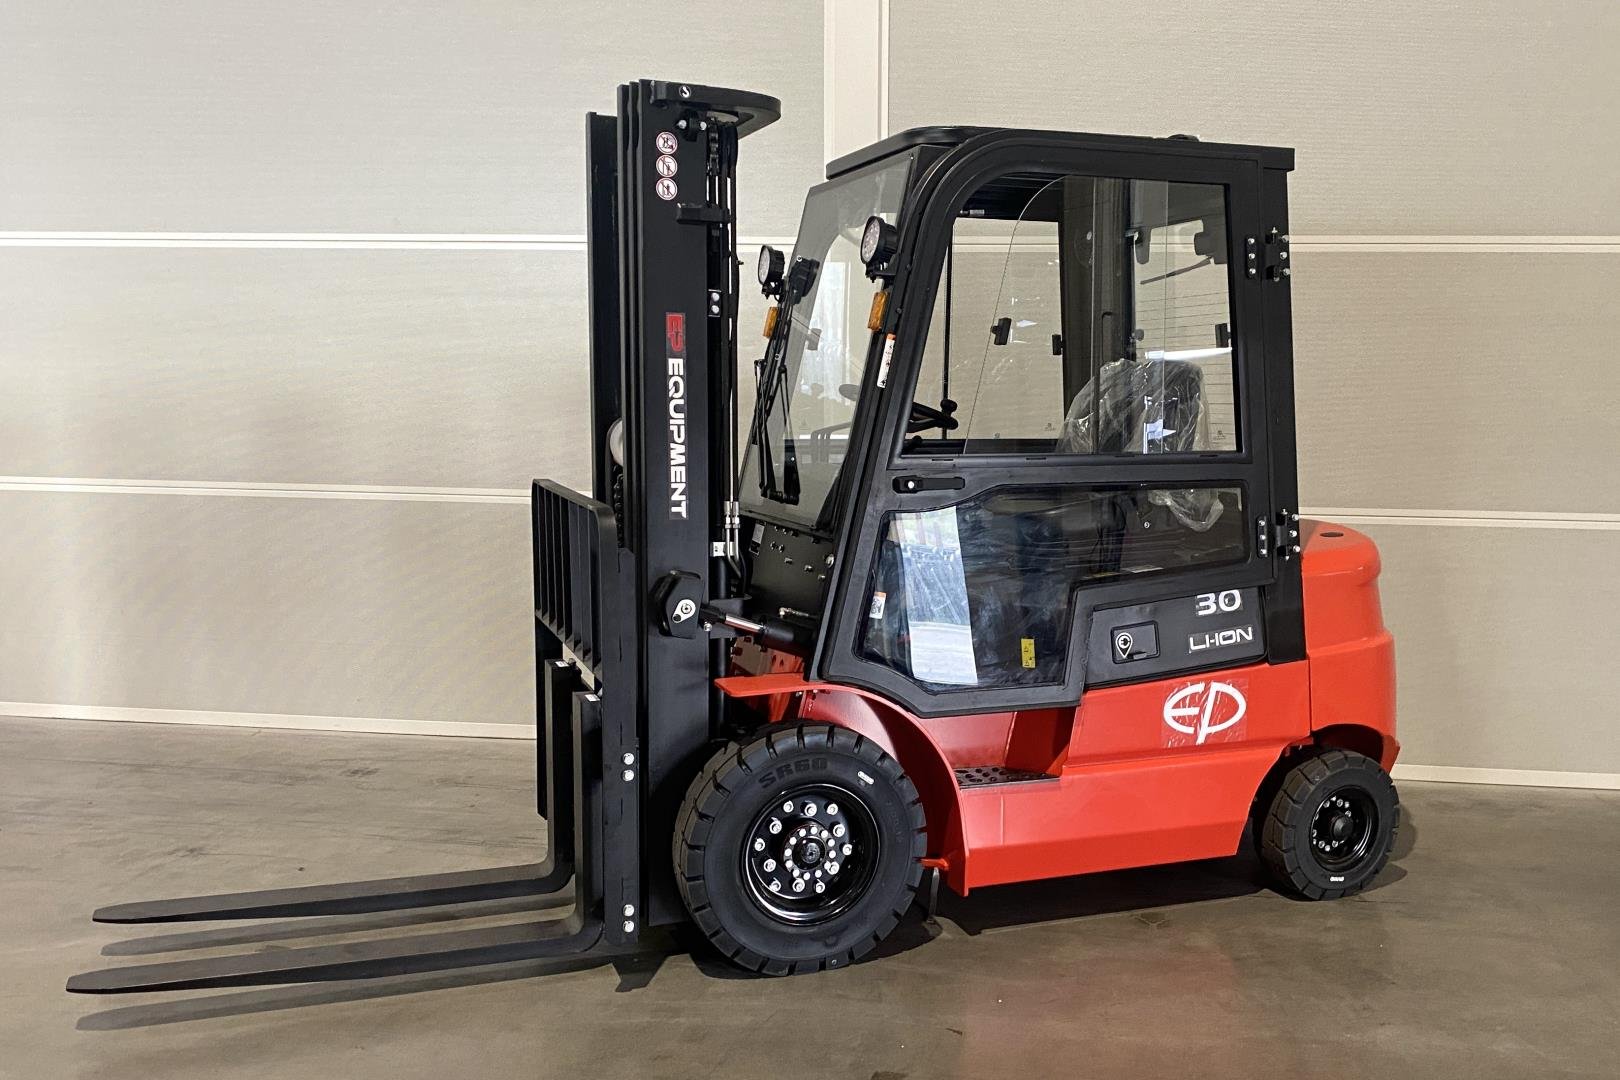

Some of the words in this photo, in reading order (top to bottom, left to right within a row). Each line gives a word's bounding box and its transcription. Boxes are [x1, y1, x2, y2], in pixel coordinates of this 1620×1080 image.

[667, 358, 687, 519] EQUIPMENT
[1196, 589, 1241, 616] 30
[1190, 627, 1253, 650] LI-ION
[1163, 681, 1247, 745] EP
